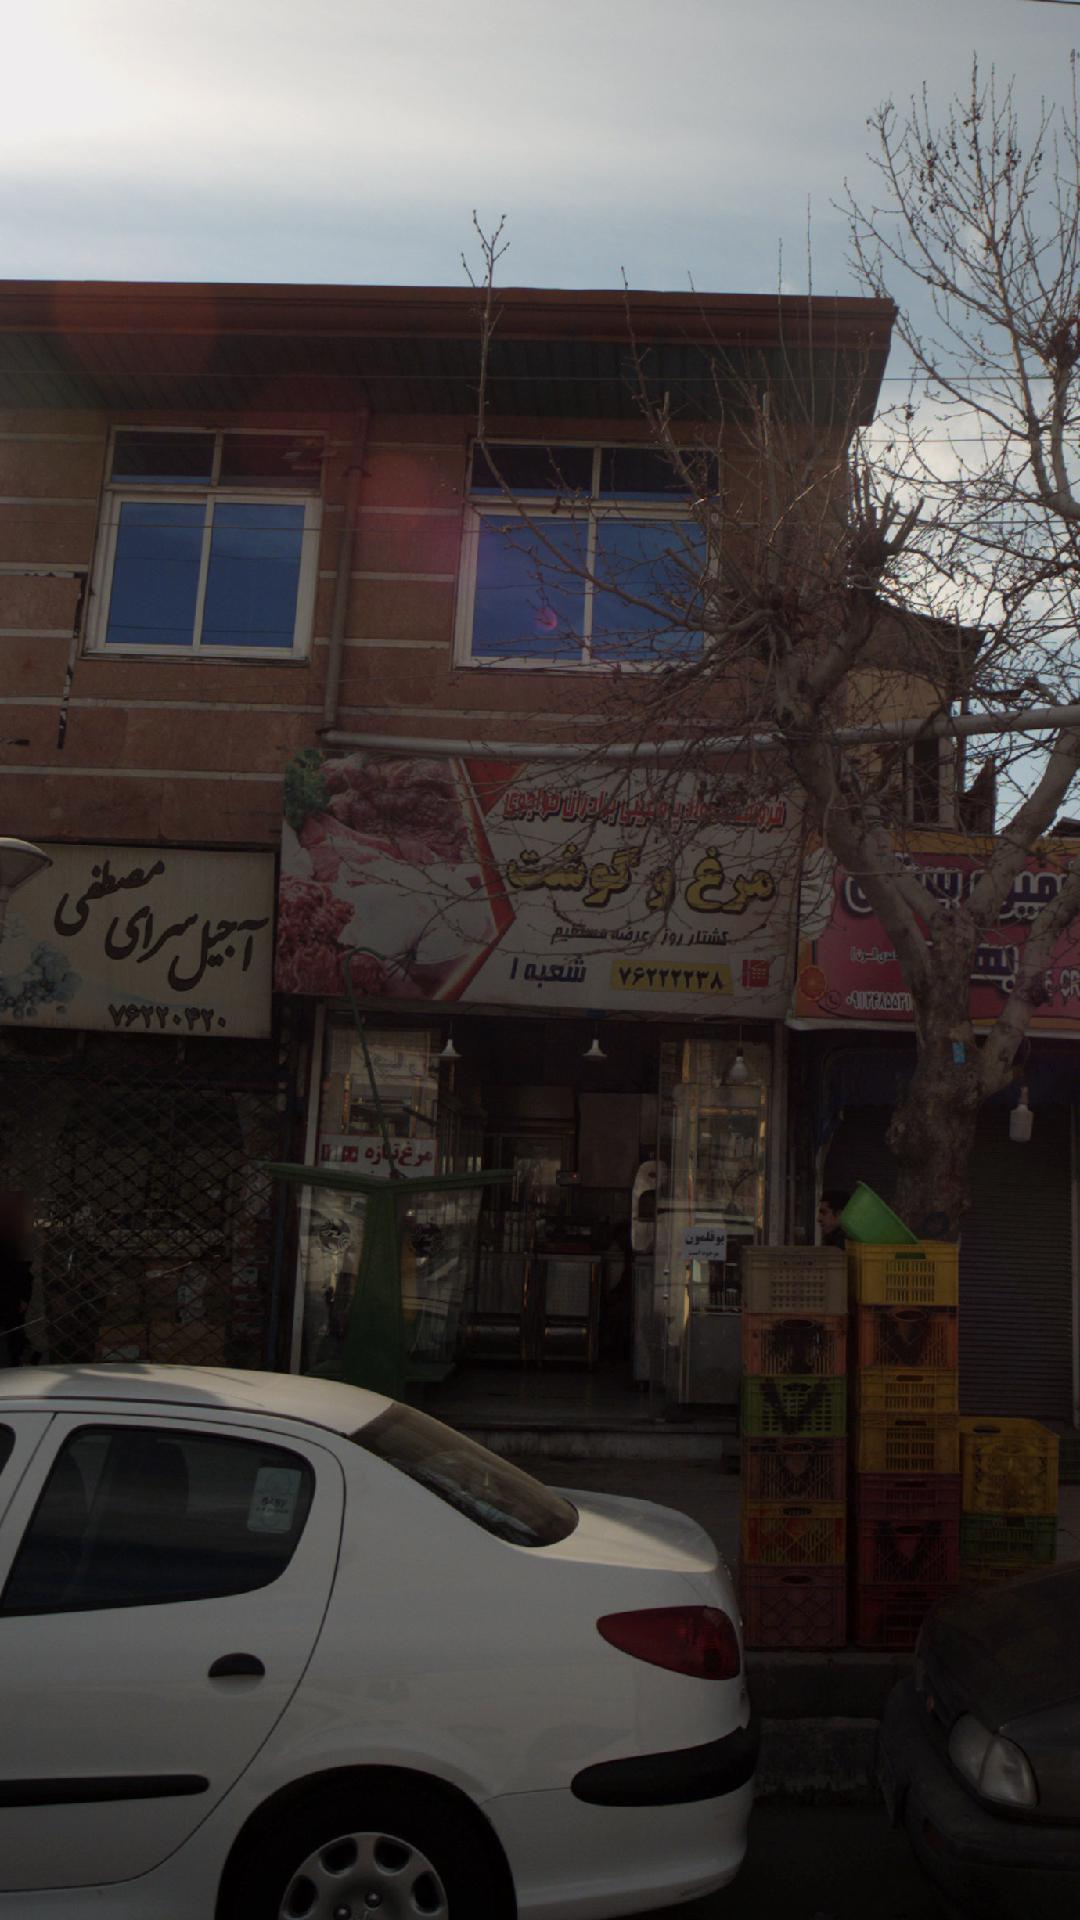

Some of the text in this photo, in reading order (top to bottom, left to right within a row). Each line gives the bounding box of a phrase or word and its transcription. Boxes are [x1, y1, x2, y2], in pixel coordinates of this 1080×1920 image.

[506, 844, 642, 907] گوشت
[646, 866, 674, 911] و
[685, 847, 777, 914] مرغ
[54, 859, 270, 992] آجیل سرای مصطفی
[611, 927, 650, 944] عرضه
[660, 928, 684, 946] روز
[688, 928, 728, 946] کشتار
[524, 956, 587, 988] شعبه
[398, 1140, 433, 1167] مرغ
[685, 1231, 725, 1246] بوقلمون
